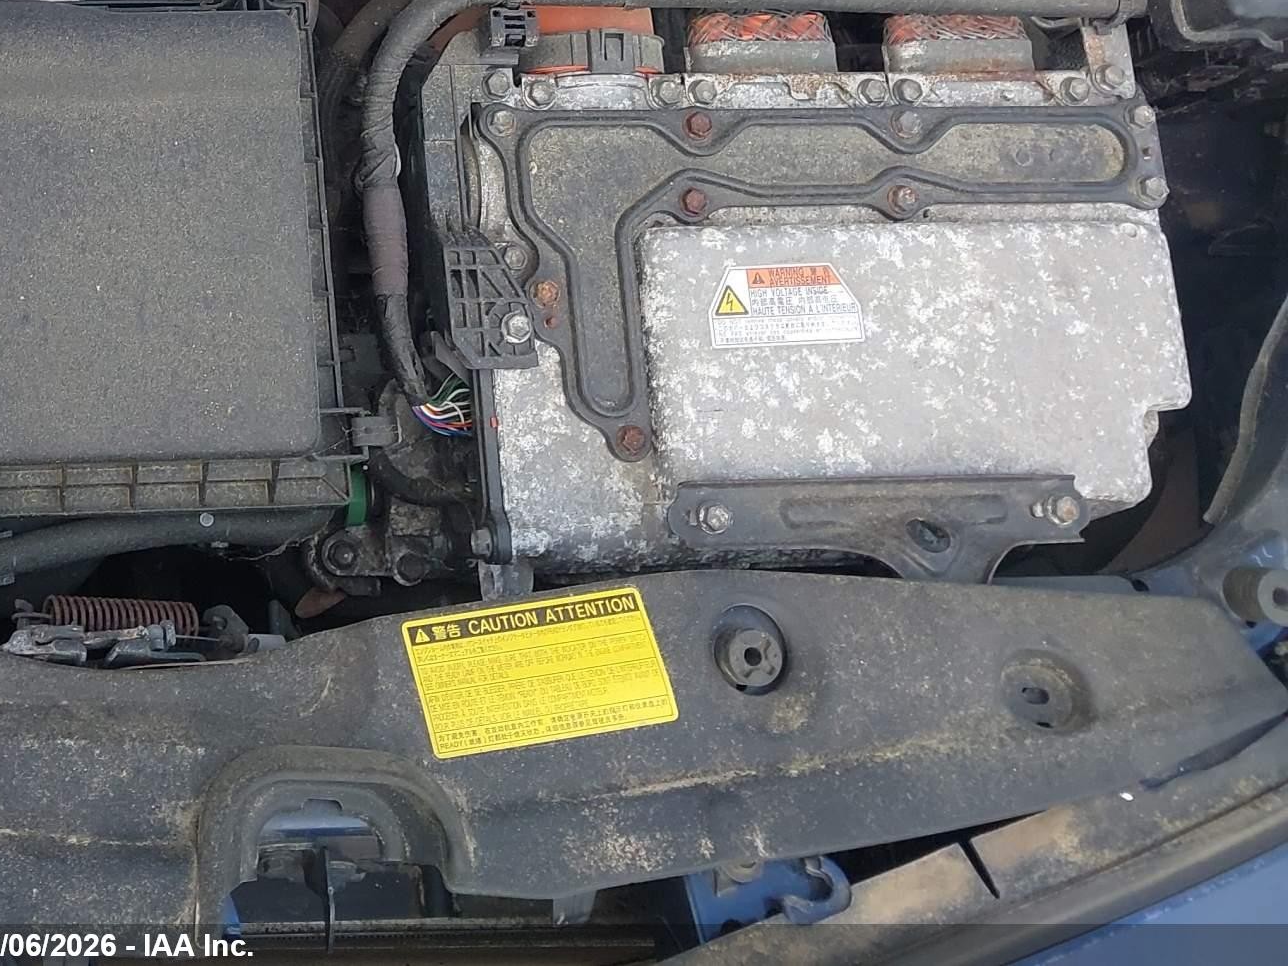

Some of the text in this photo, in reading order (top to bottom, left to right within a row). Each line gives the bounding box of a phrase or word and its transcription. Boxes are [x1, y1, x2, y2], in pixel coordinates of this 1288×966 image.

[768, 268, 804, 277] WARNING
[770, 276, 832, 286] AVERTISSEMENT
[750, 290, 767, 298] HIGH
[772, 288, 802, 296] VOLTAGE
[752, 306, 774, 316] HAUTE
[778, 306, 806, 314] TENSION
[431, 624, 461, 642] 警告
[468, 611, 538, 635] CAUTION
[546, 596, 636, 624] ATTENTION
